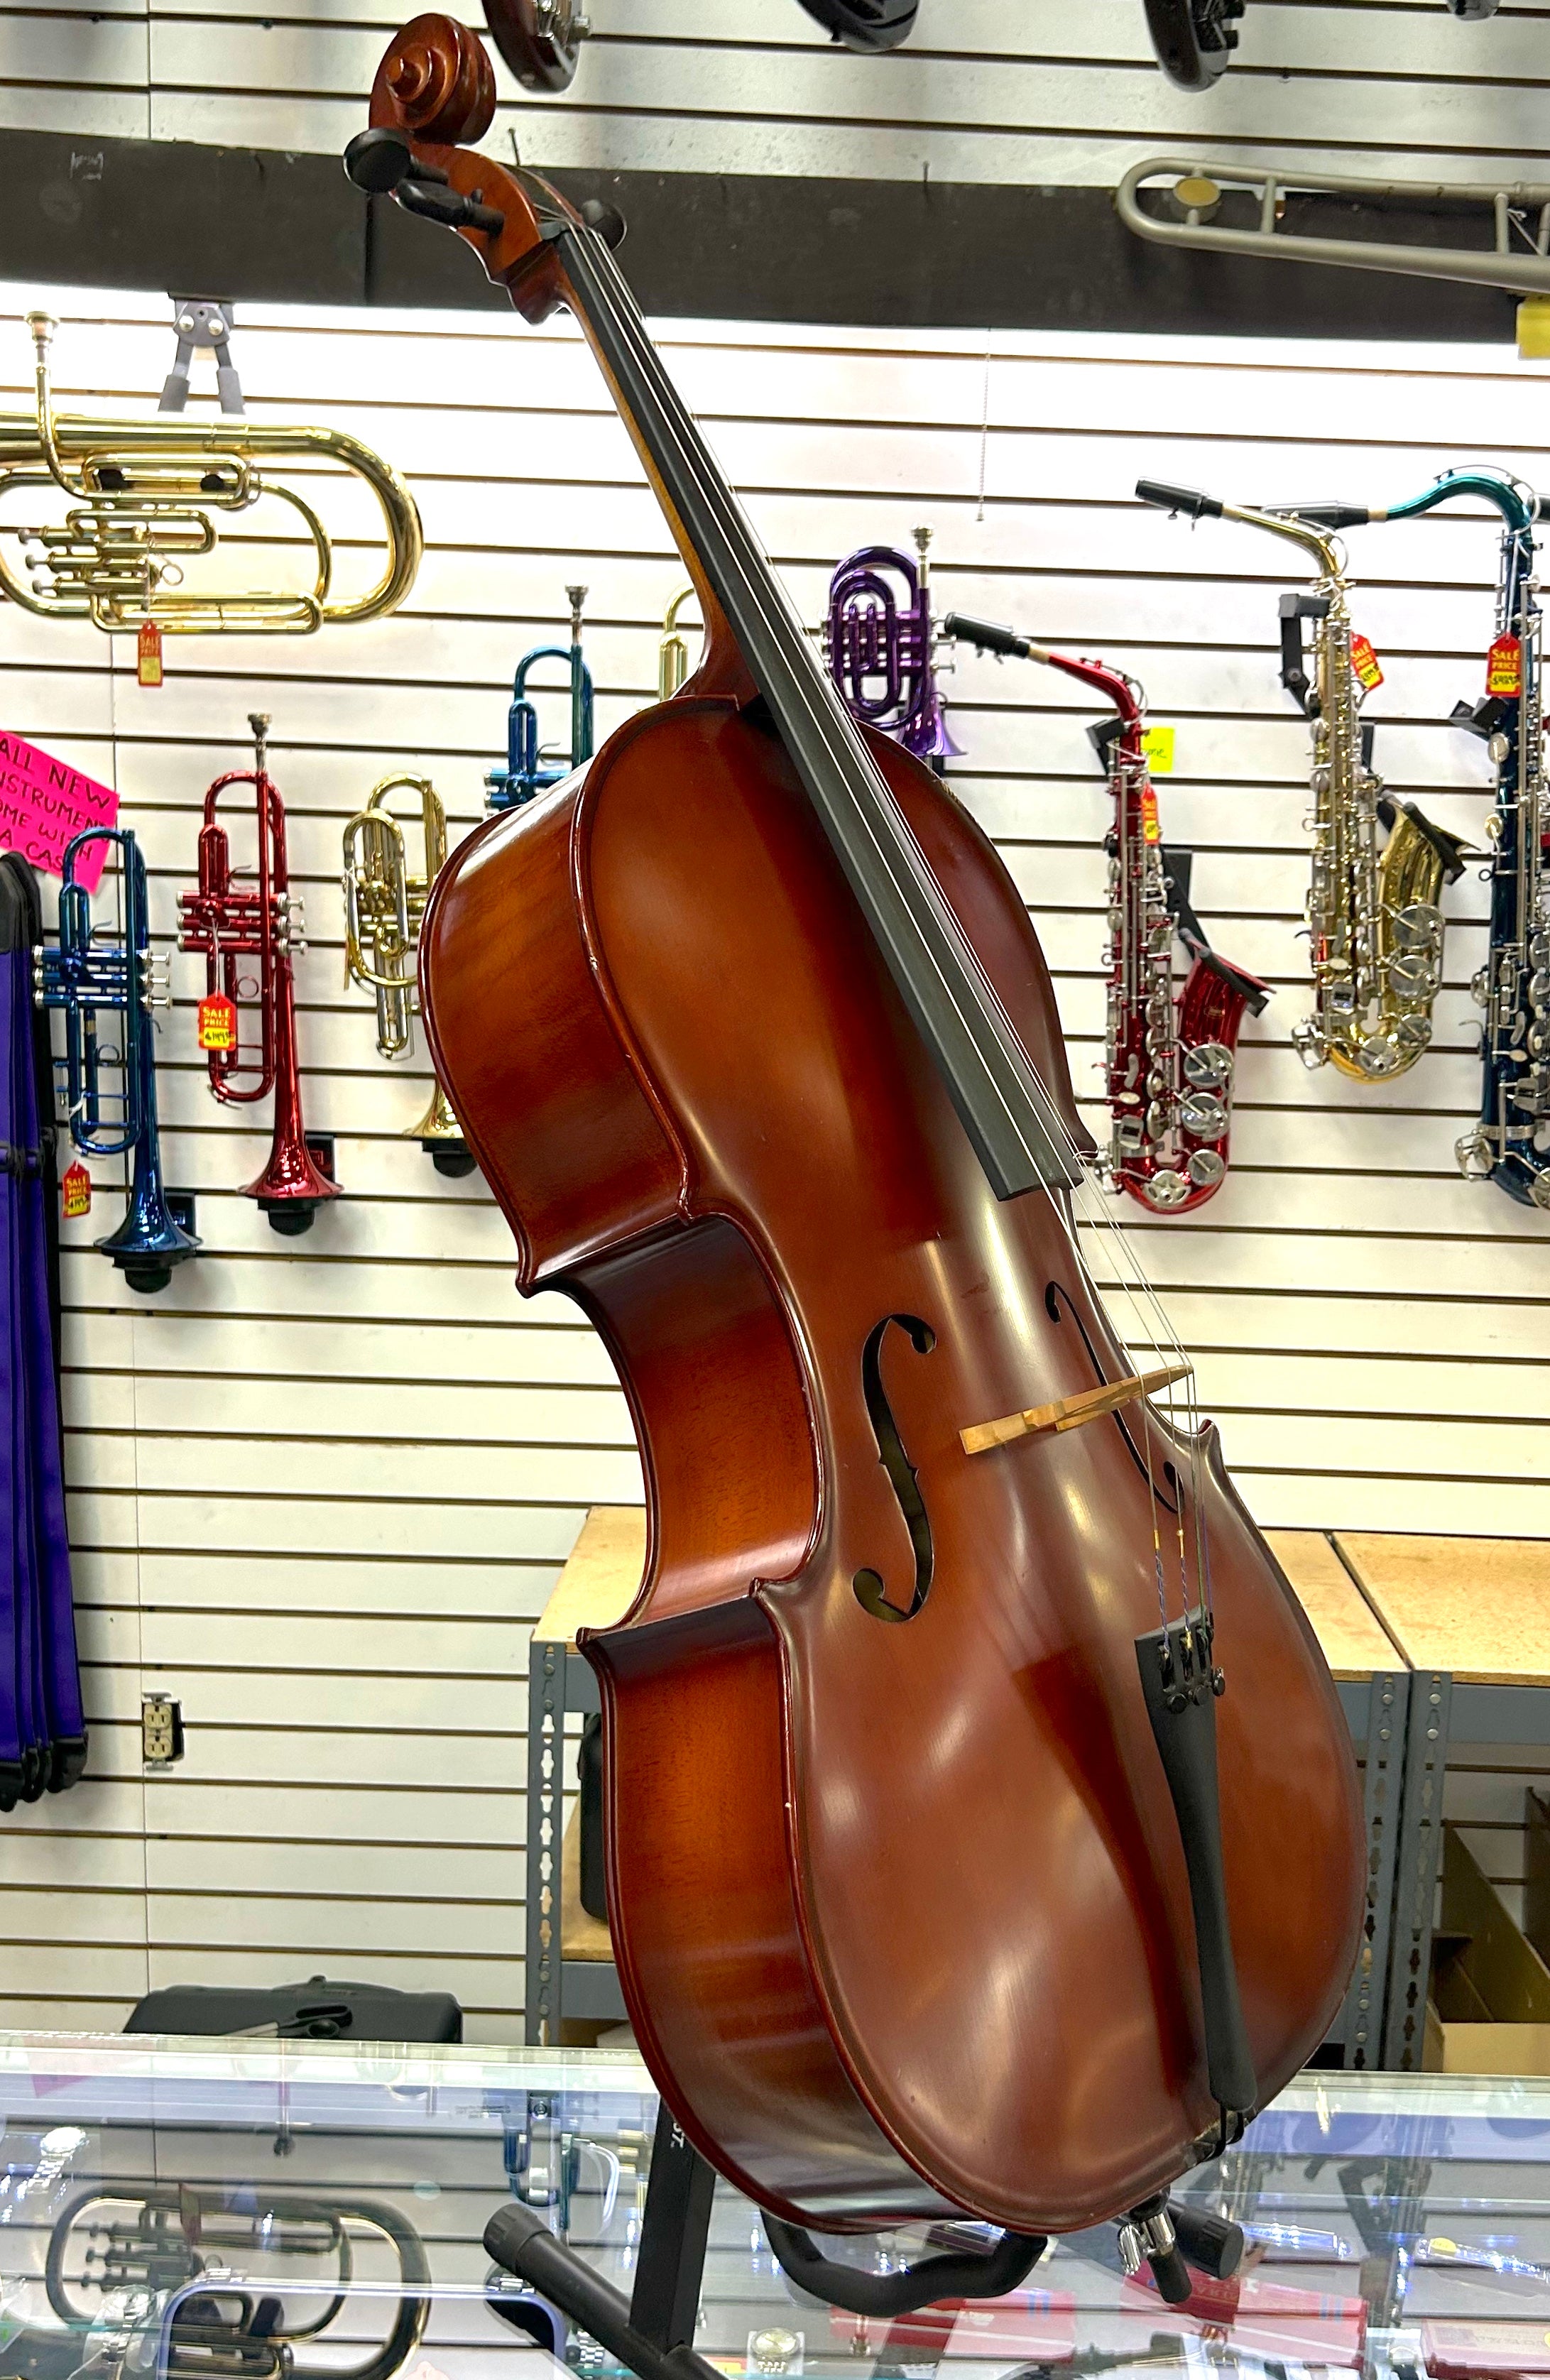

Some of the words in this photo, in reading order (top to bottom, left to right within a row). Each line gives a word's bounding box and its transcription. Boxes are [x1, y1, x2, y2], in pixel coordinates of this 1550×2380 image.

[1492, 648, 1520, 661] SALE
[0, 738, 35, 775] ALL
[48, 764, 110, 809] NEW
[0, 828, 13, 847] A
[25, 841, 64, 872] CAS
[38, 822, 93, 861] WIH
[203, 1006, 231, 1019] SALE
